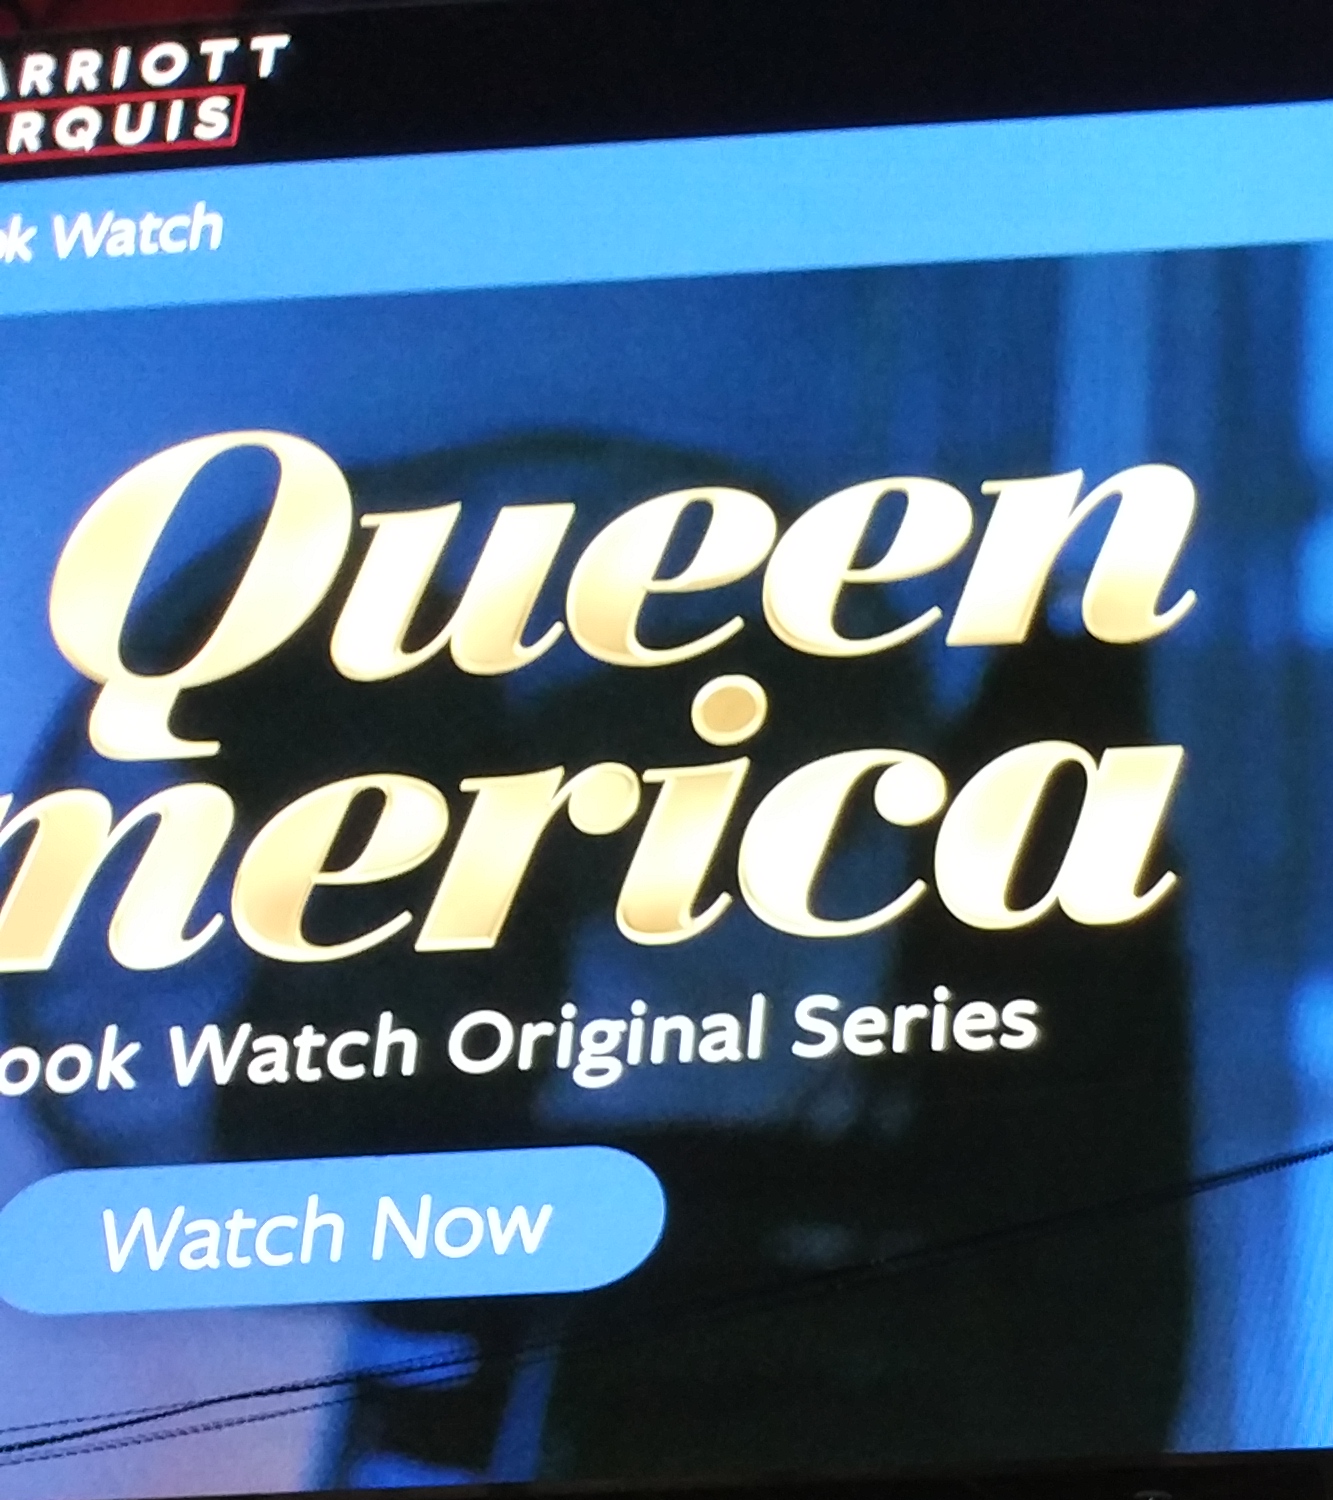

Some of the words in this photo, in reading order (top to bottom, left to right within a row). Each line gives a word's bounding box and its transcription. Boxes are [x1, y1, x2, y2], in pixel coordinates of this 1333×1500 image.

[0, 212, 38, 263] k
[53, 199, 224, 260] Watch
[46, 428, 1199, 762] Queen
[169, 1011, 419, 1090] Watch
[447, 988, 764, 1091] Original
[791, 983, 1041, 1059] Series
[100, 1199, 345, 1274] Watch
[371, 1193, 556, 1261] Now
